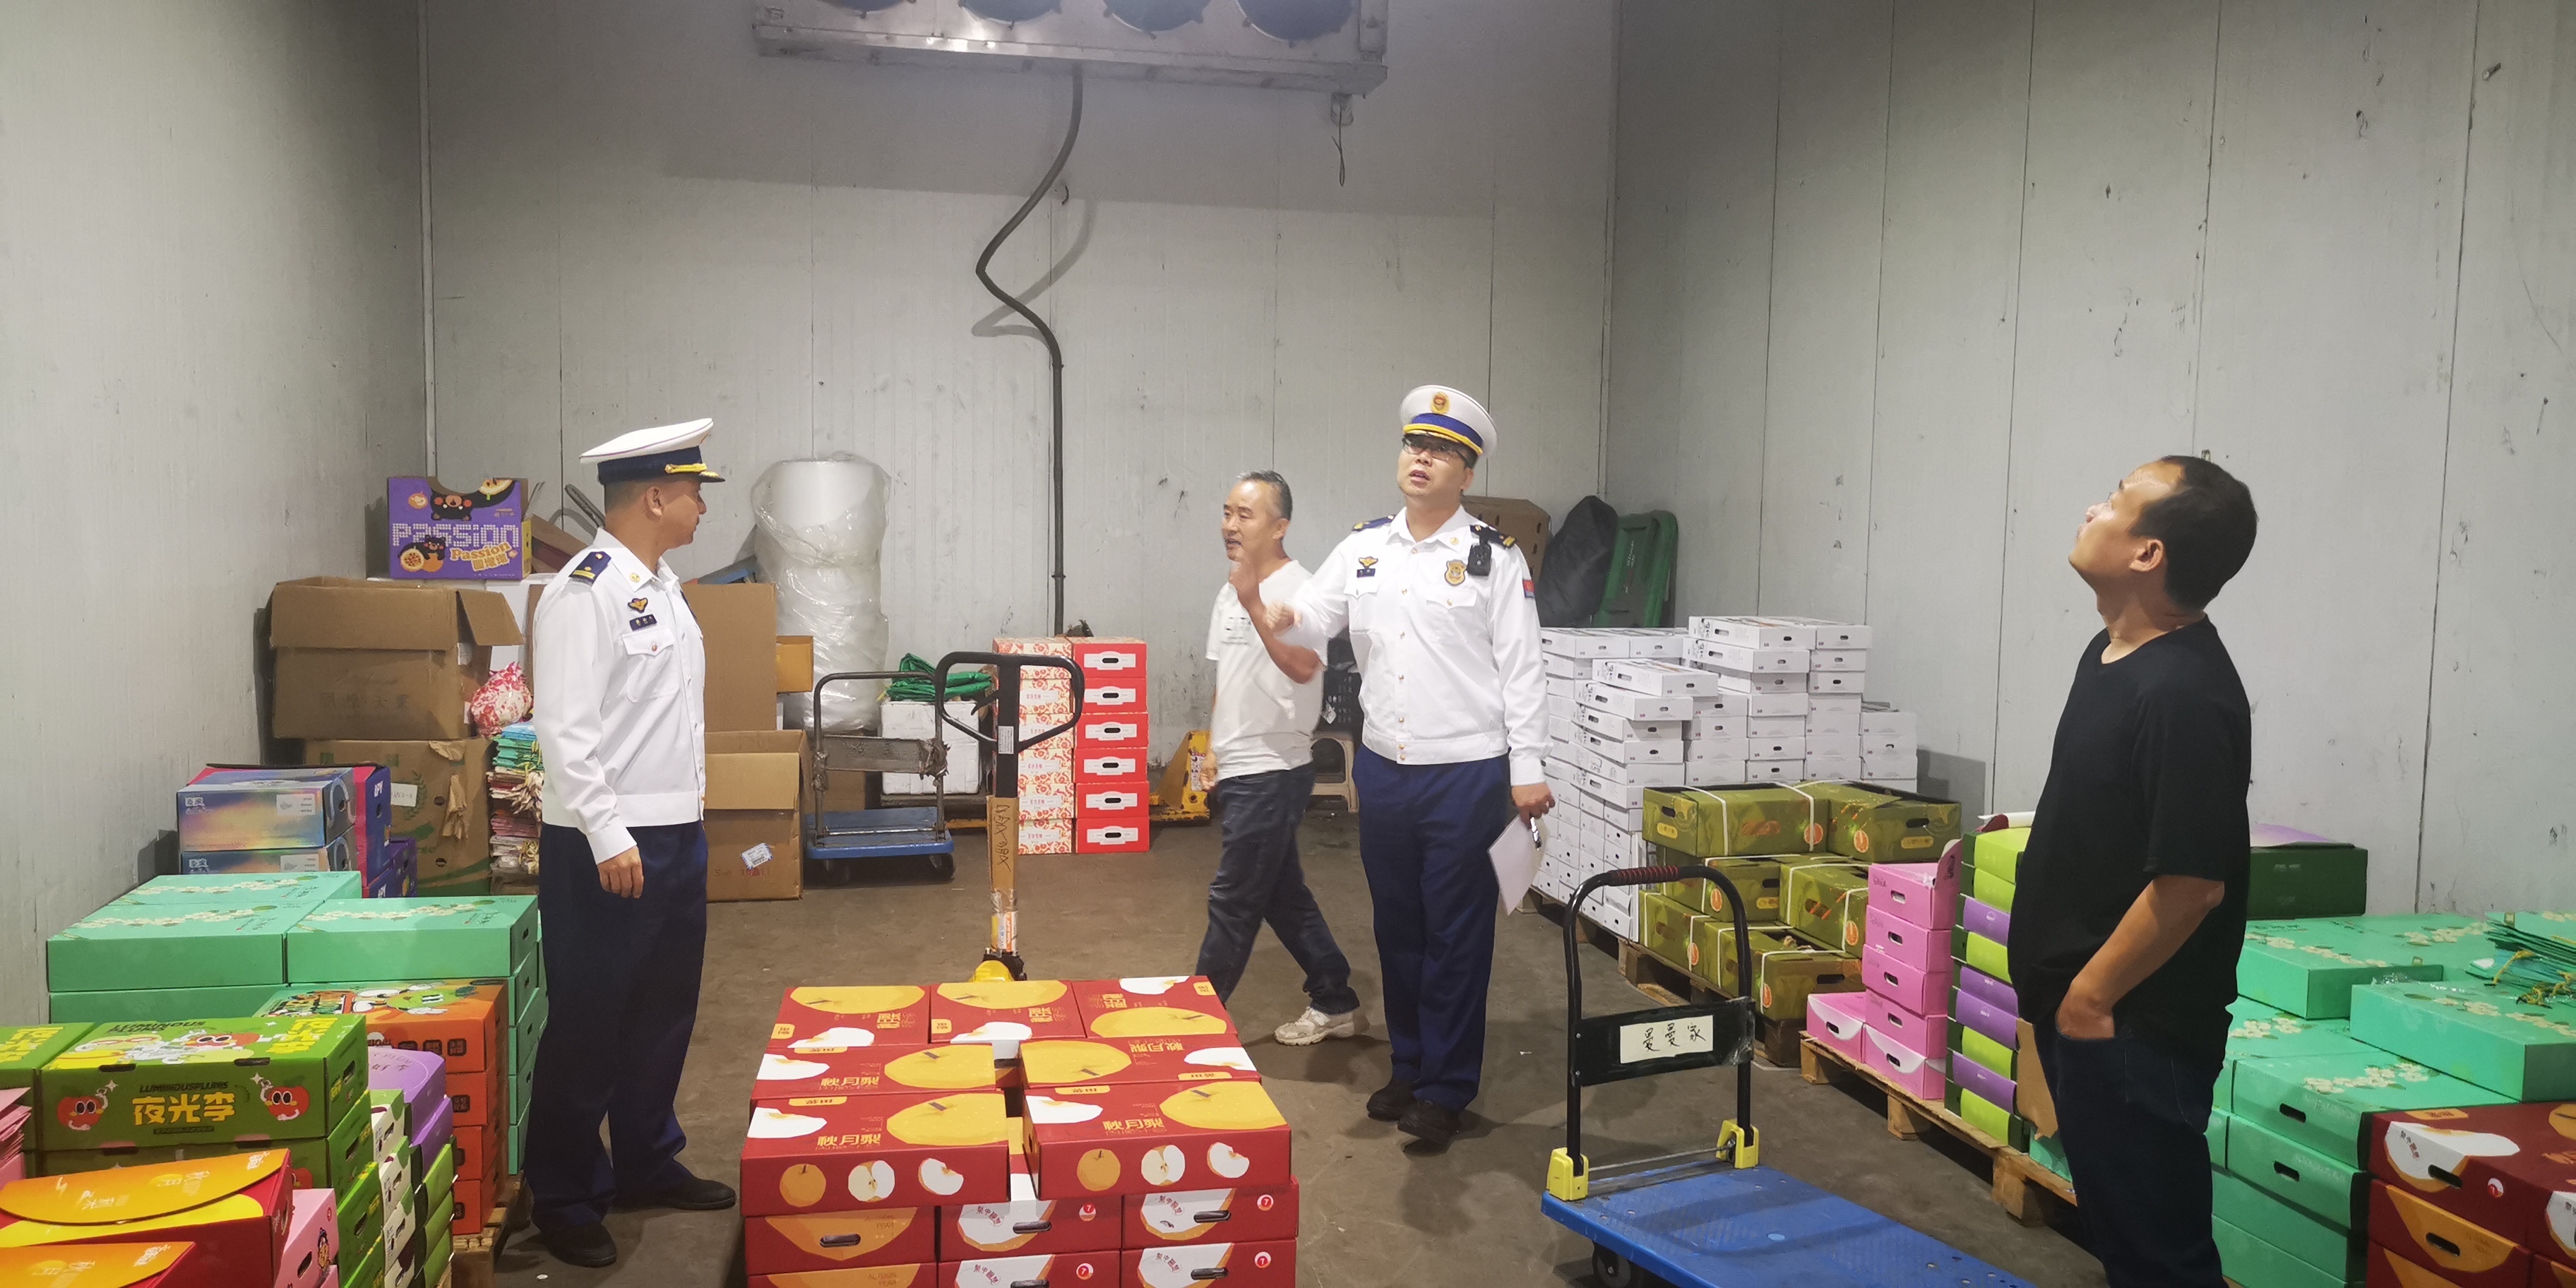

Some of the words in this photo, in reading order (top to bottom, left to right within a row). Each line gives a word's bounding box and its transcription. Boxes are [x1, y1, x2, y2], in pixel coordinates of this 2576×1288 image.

[451, 542, 511, 560] Passion
[1643, 1022, 1706, 1051] 曼曼家
[821, 1076, 880, 1087] 秋月梨
[132, 1091, 235, 1126] 夜光李
[1102, 1118, 1164, 1131] 秋月梨
[817, 1133, 881, 1147] 秋月梨
